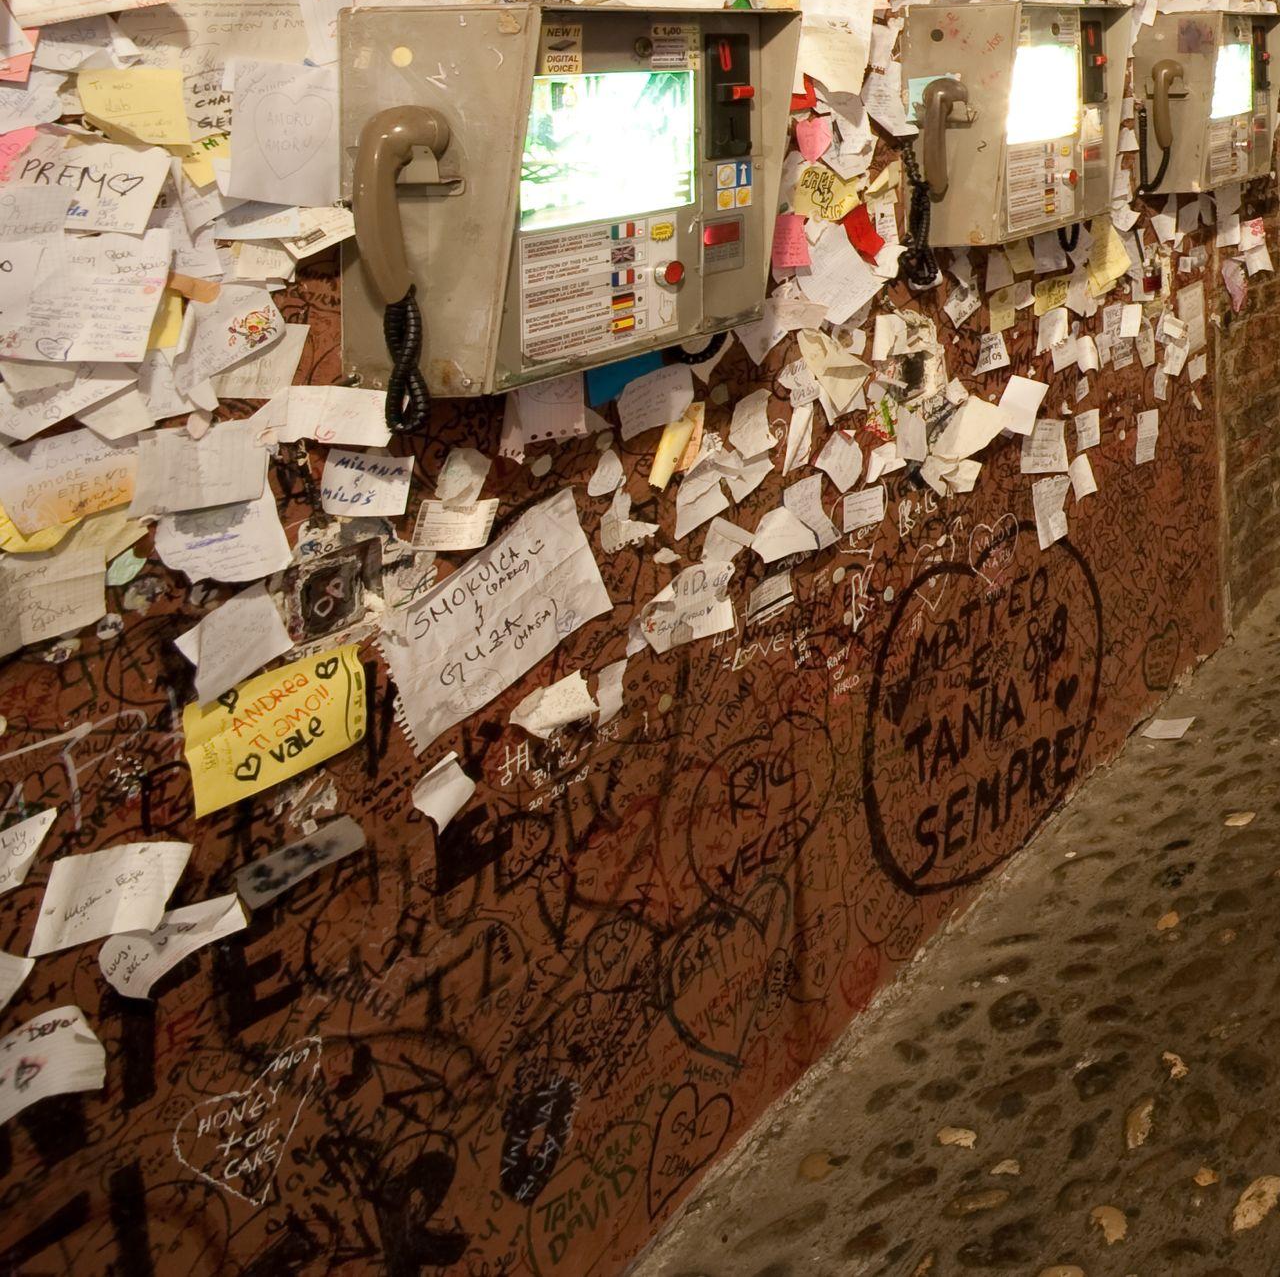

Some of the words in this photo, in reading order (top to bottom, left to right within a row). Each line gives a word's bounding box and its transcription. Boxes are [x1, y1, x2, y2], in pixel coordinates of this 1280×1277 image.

[546, 27, 571, 37] NEW
[546, 54, 579, 64] DIGITAL
[547, 64, 574, 73] VOICE
[904, 676, 1027, 783] TANIA
[197, 1080, 283, 1138] HONEY
[245, 1117, 281, 1146] CUP
[224, 1141, 277, 1180] CAKE
